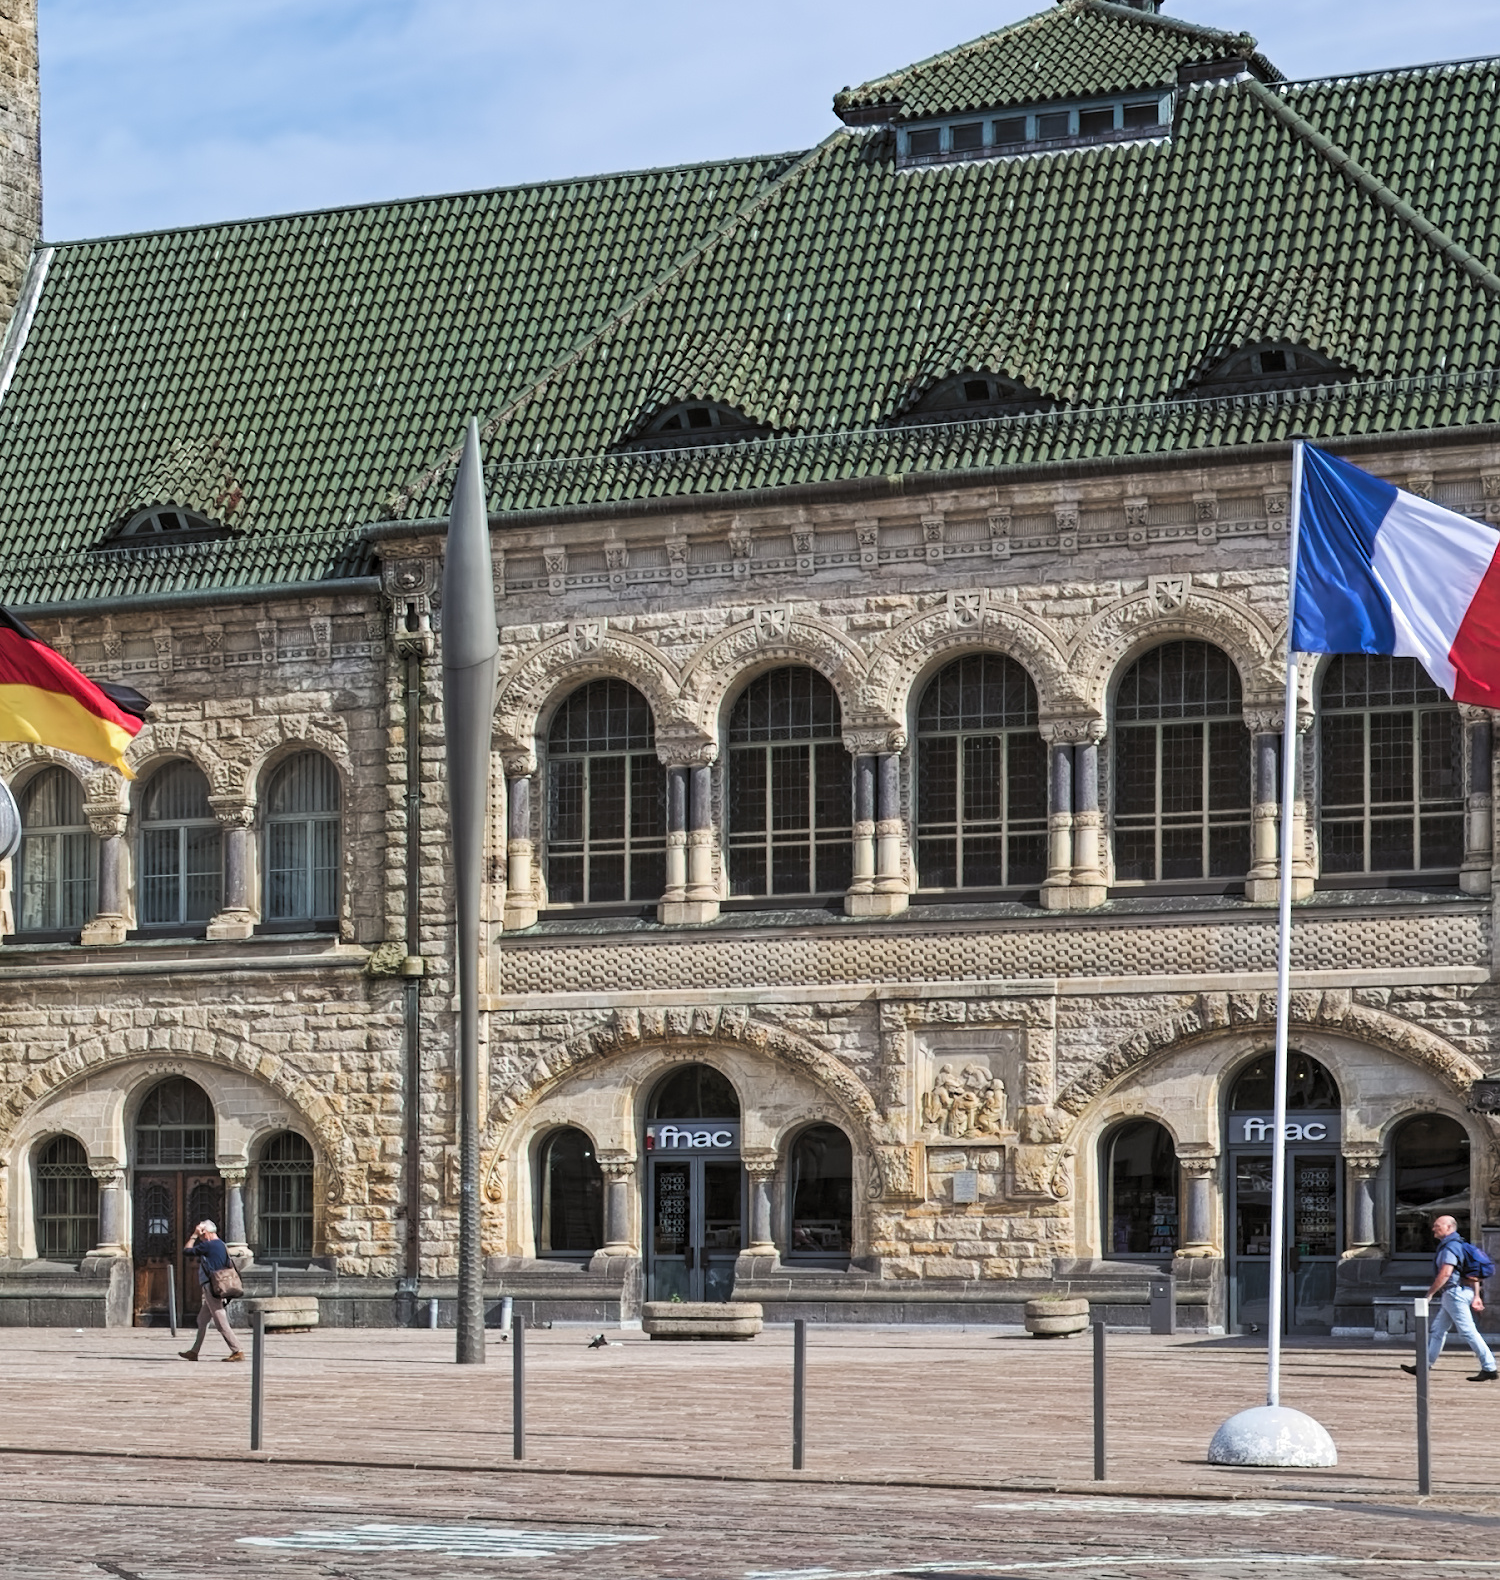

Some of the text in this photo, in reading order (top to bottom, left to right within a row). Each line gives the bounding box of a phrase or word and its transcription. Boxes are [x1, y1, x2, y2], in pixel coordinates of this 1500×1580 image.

[1243, 1117, 1327, 1141] fnac
[659, 1125, 733, 1148] fnac
[660, 1176, 685, 1184] 07H00
[1301, 1171, 1330, 1180] 07H00
[1301, 1179, 1330, 1187] 20H00
